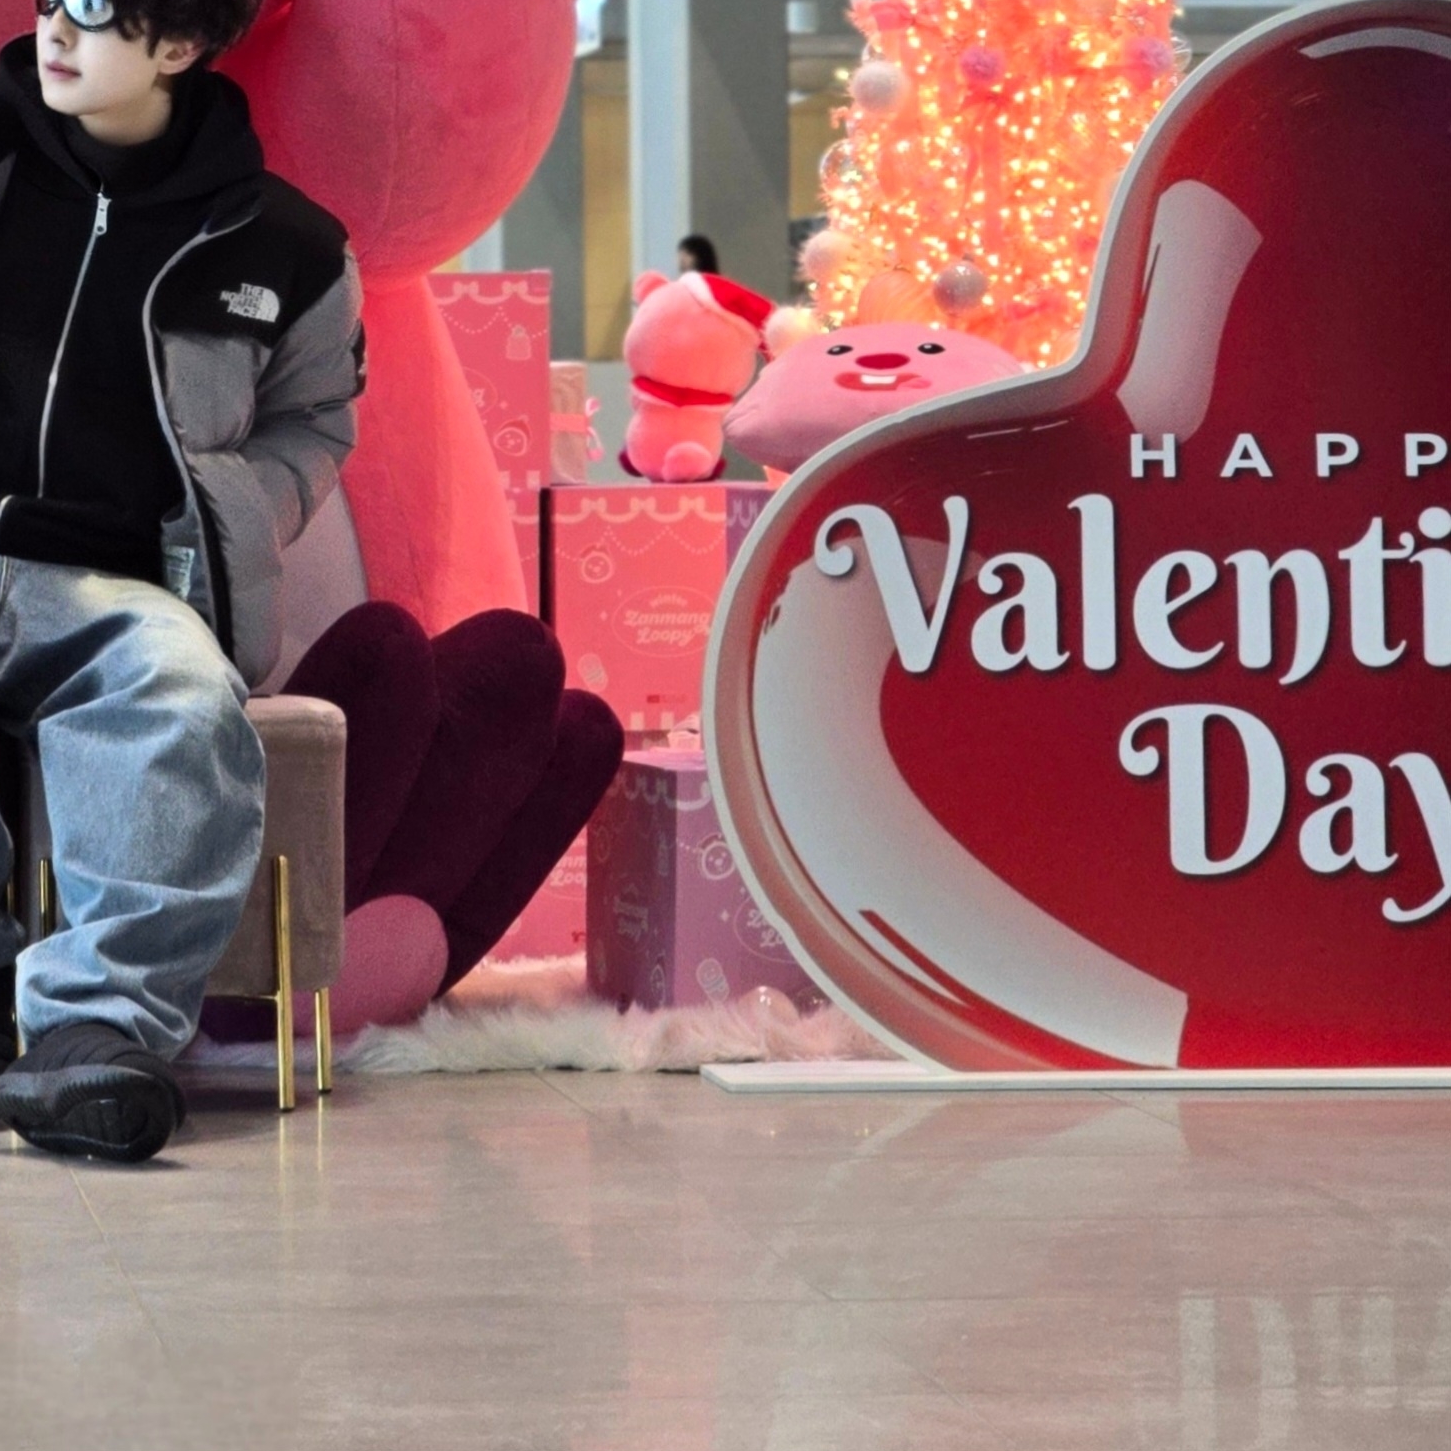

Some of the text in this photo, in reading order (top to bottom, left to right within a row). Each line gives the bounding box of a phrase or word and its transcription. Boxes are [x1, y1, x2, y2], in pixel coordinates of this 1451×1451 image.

[240, 283, 263, 298] THE
[219, 290, 261, 308] NORTH
[227, 303, 258, 318] FACE
[636, 628, 695, 647] Loopy
